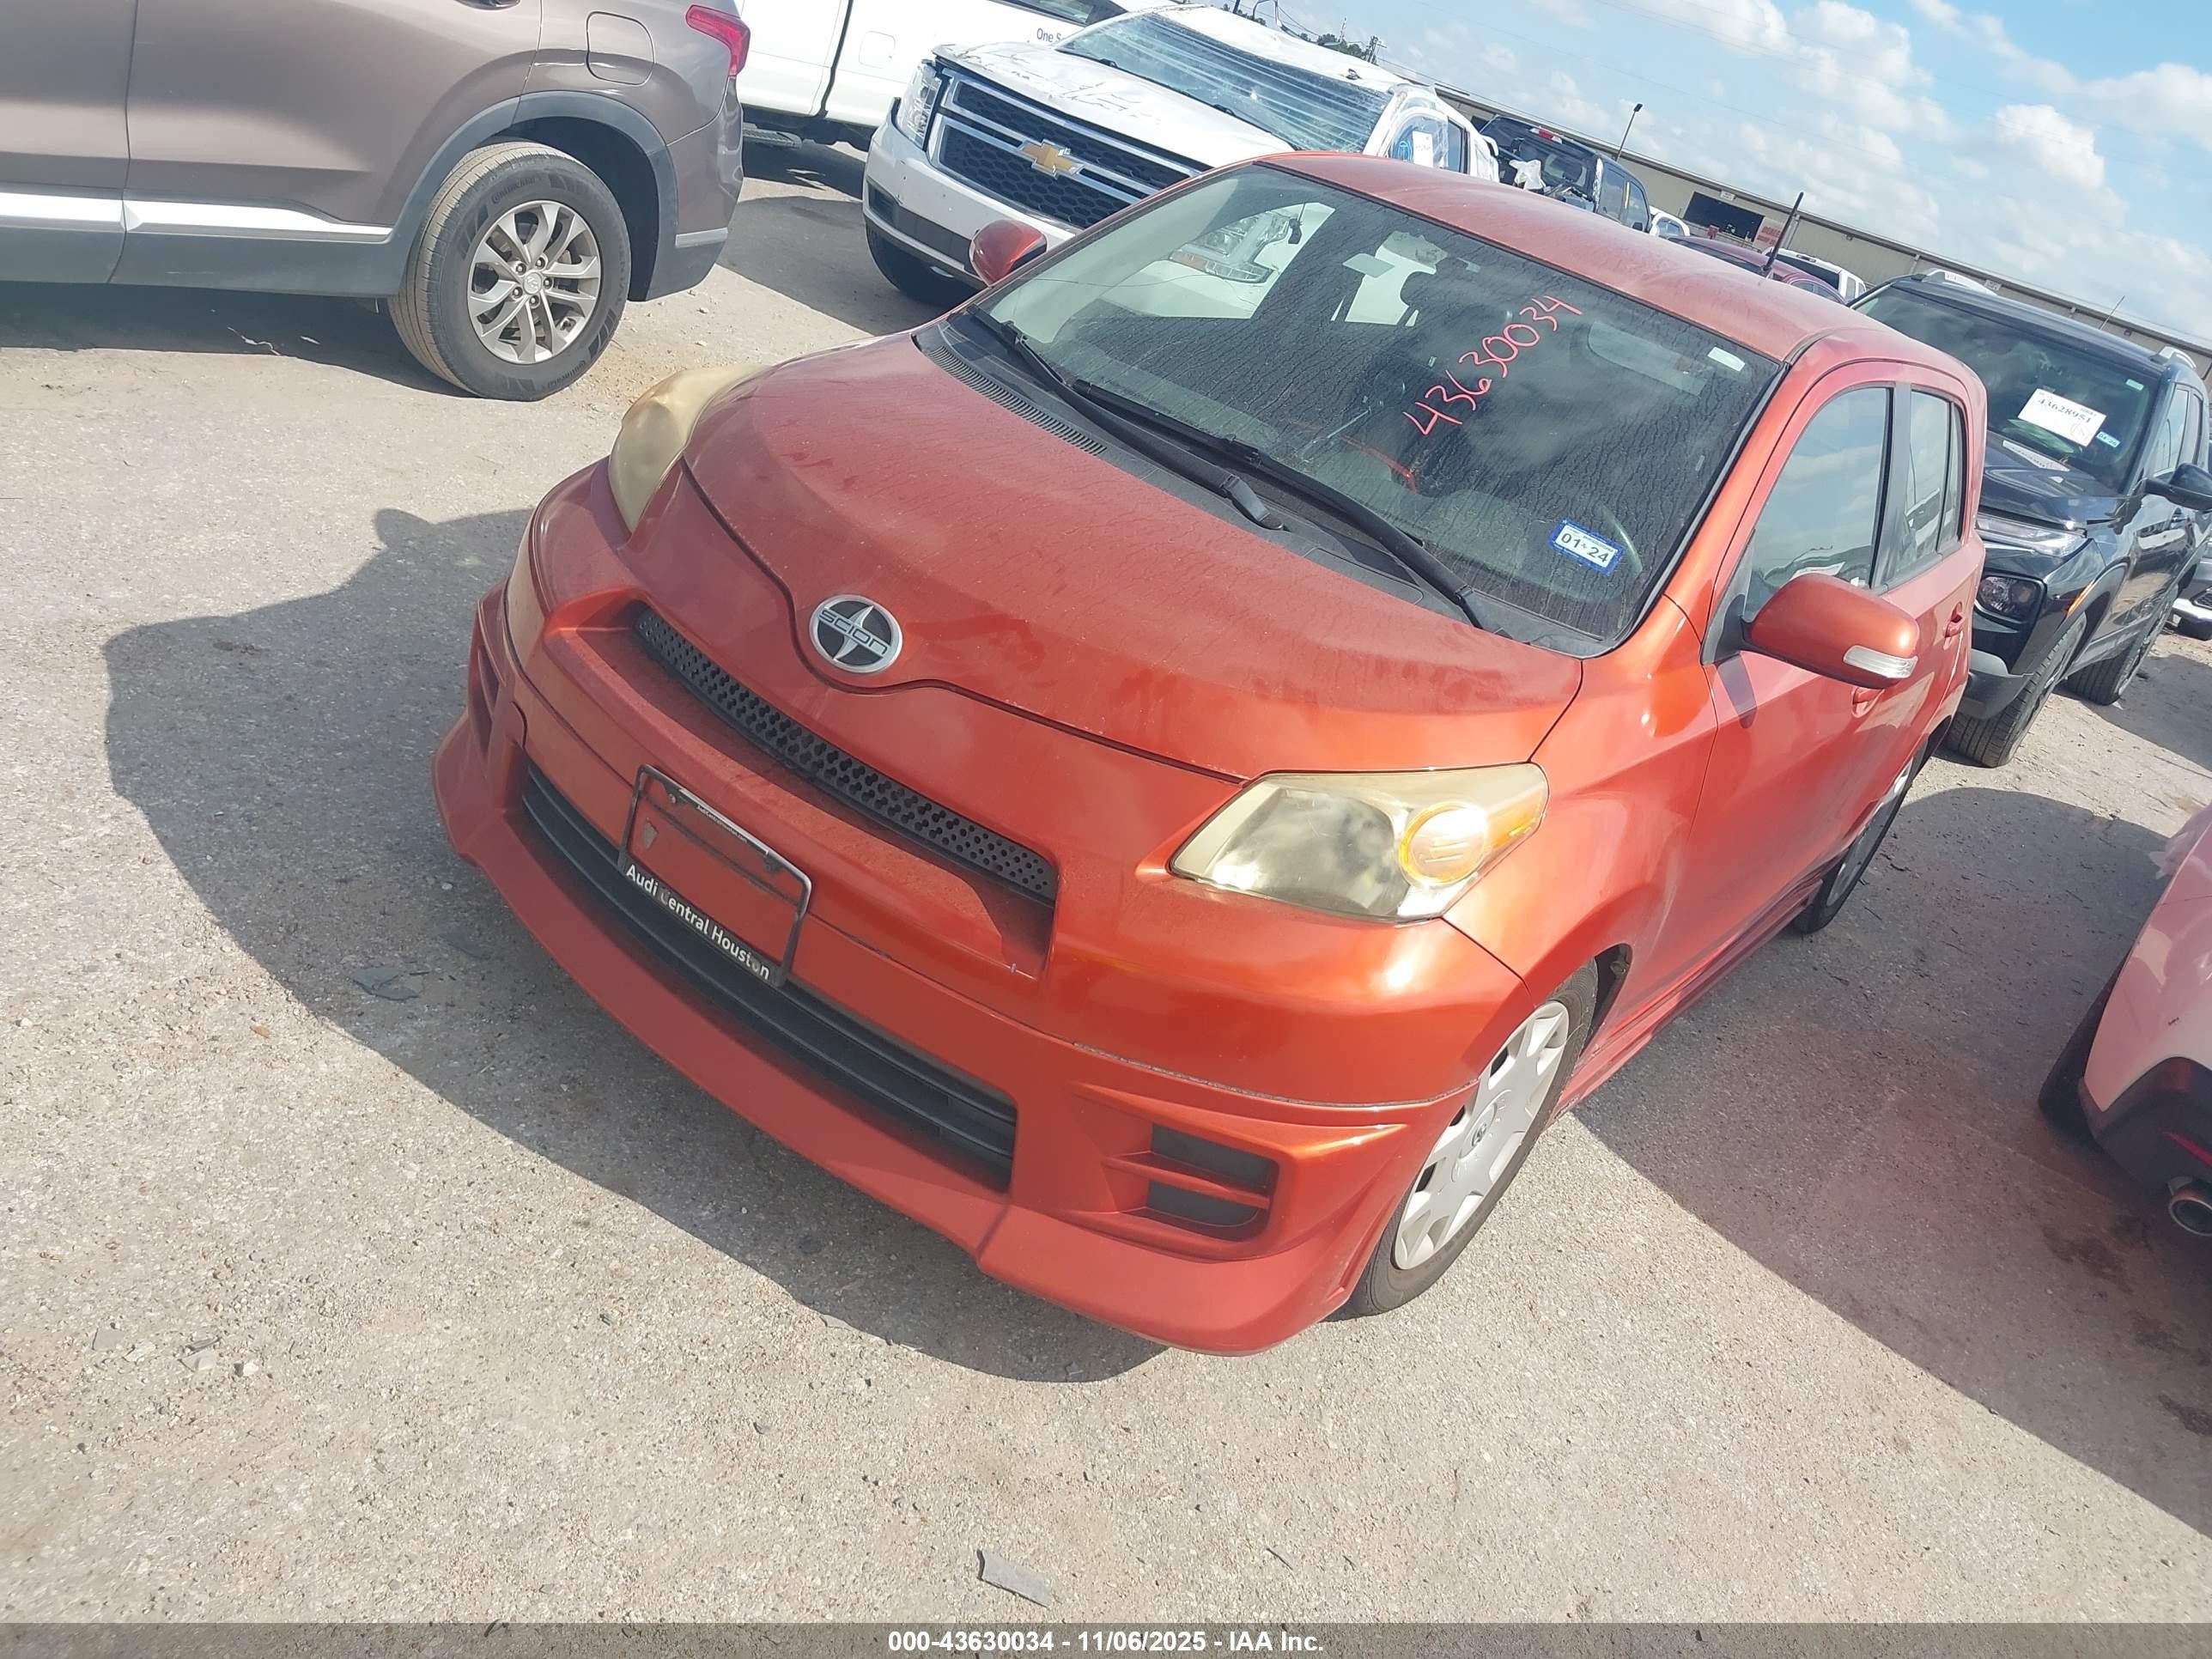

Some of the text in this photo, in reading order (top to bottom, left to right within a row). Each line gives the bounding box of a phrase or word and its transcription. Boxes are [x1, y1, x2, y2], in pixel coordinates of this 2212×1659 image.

[1036, 27, 1054, 42] One
[1402, 295, 1583, 435] 43630034
[2038, 398, 2092, 423] 43628951
[818, 609, 888, 655] SCION
[625, 864, 659, 896] Audi
[711, 925, 769, 981] Houston
